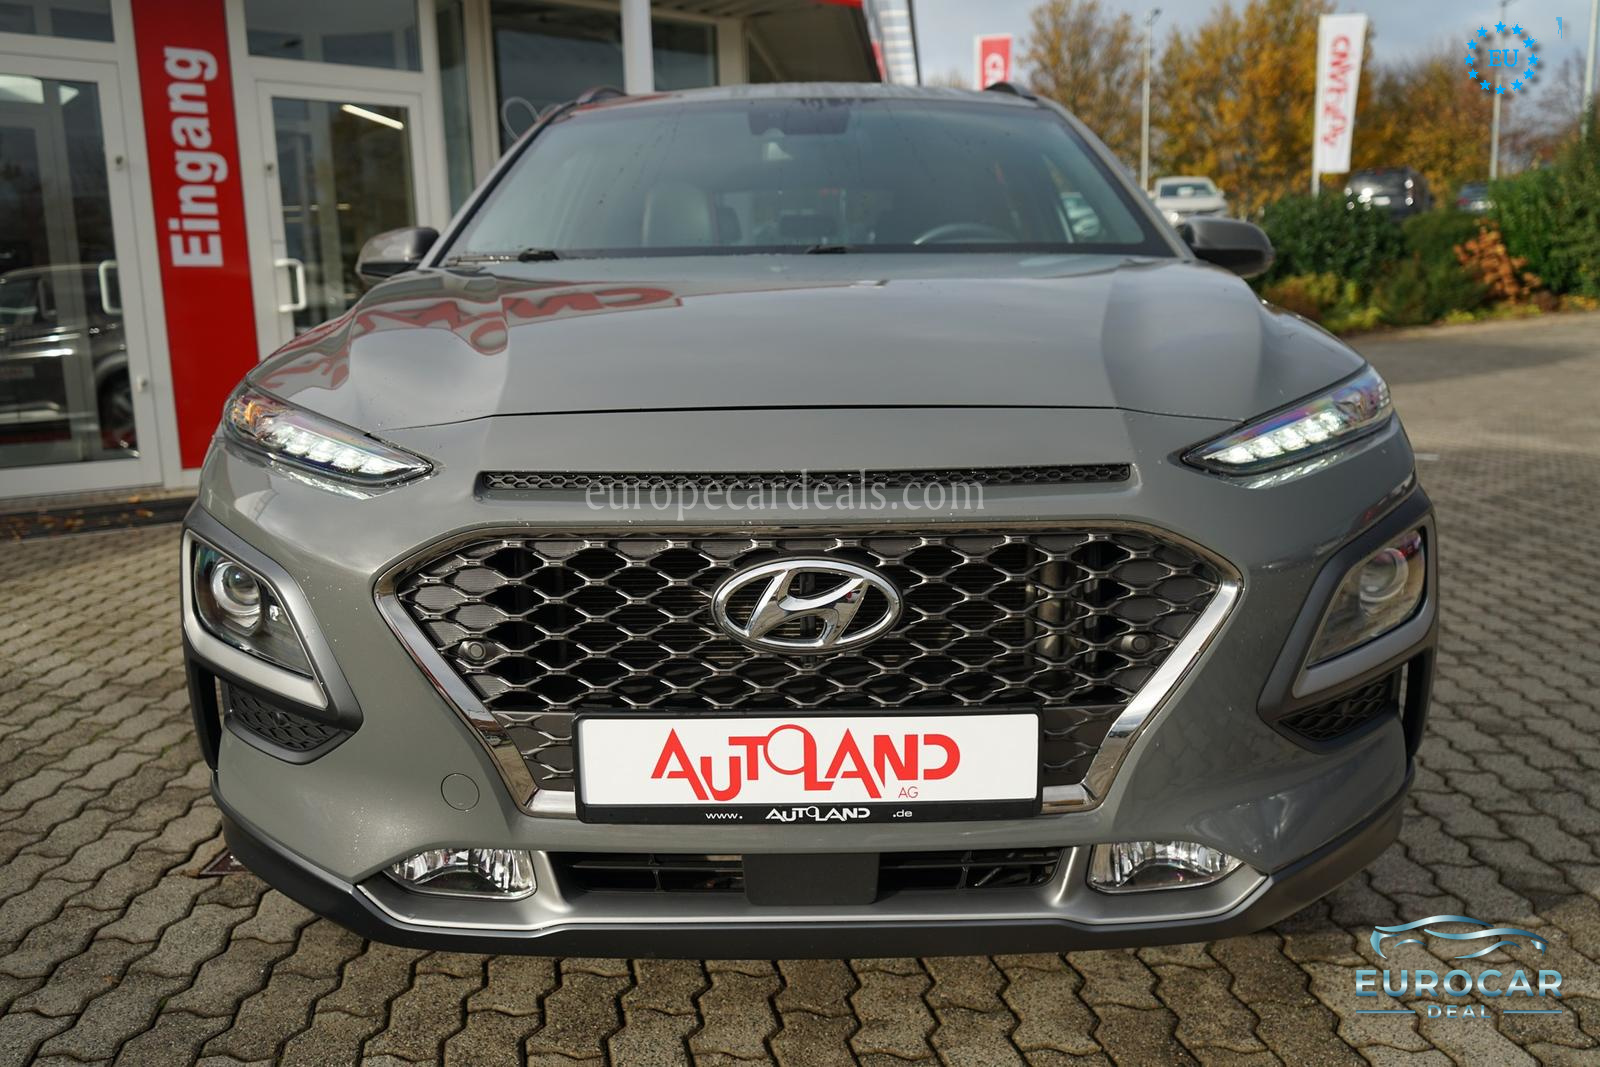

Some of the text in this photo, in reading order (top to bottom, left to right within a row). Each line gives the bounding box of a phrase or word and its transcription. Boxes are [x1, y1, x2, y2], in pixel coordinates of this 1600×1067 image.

[163, 46, 229, 268] Eingang
[650, 723, 961, 802] AUTOLAND
[705, 811, 743, 820] www.
[892, 809, 913, 819] .de
[898, 786, 919, 799] AG
